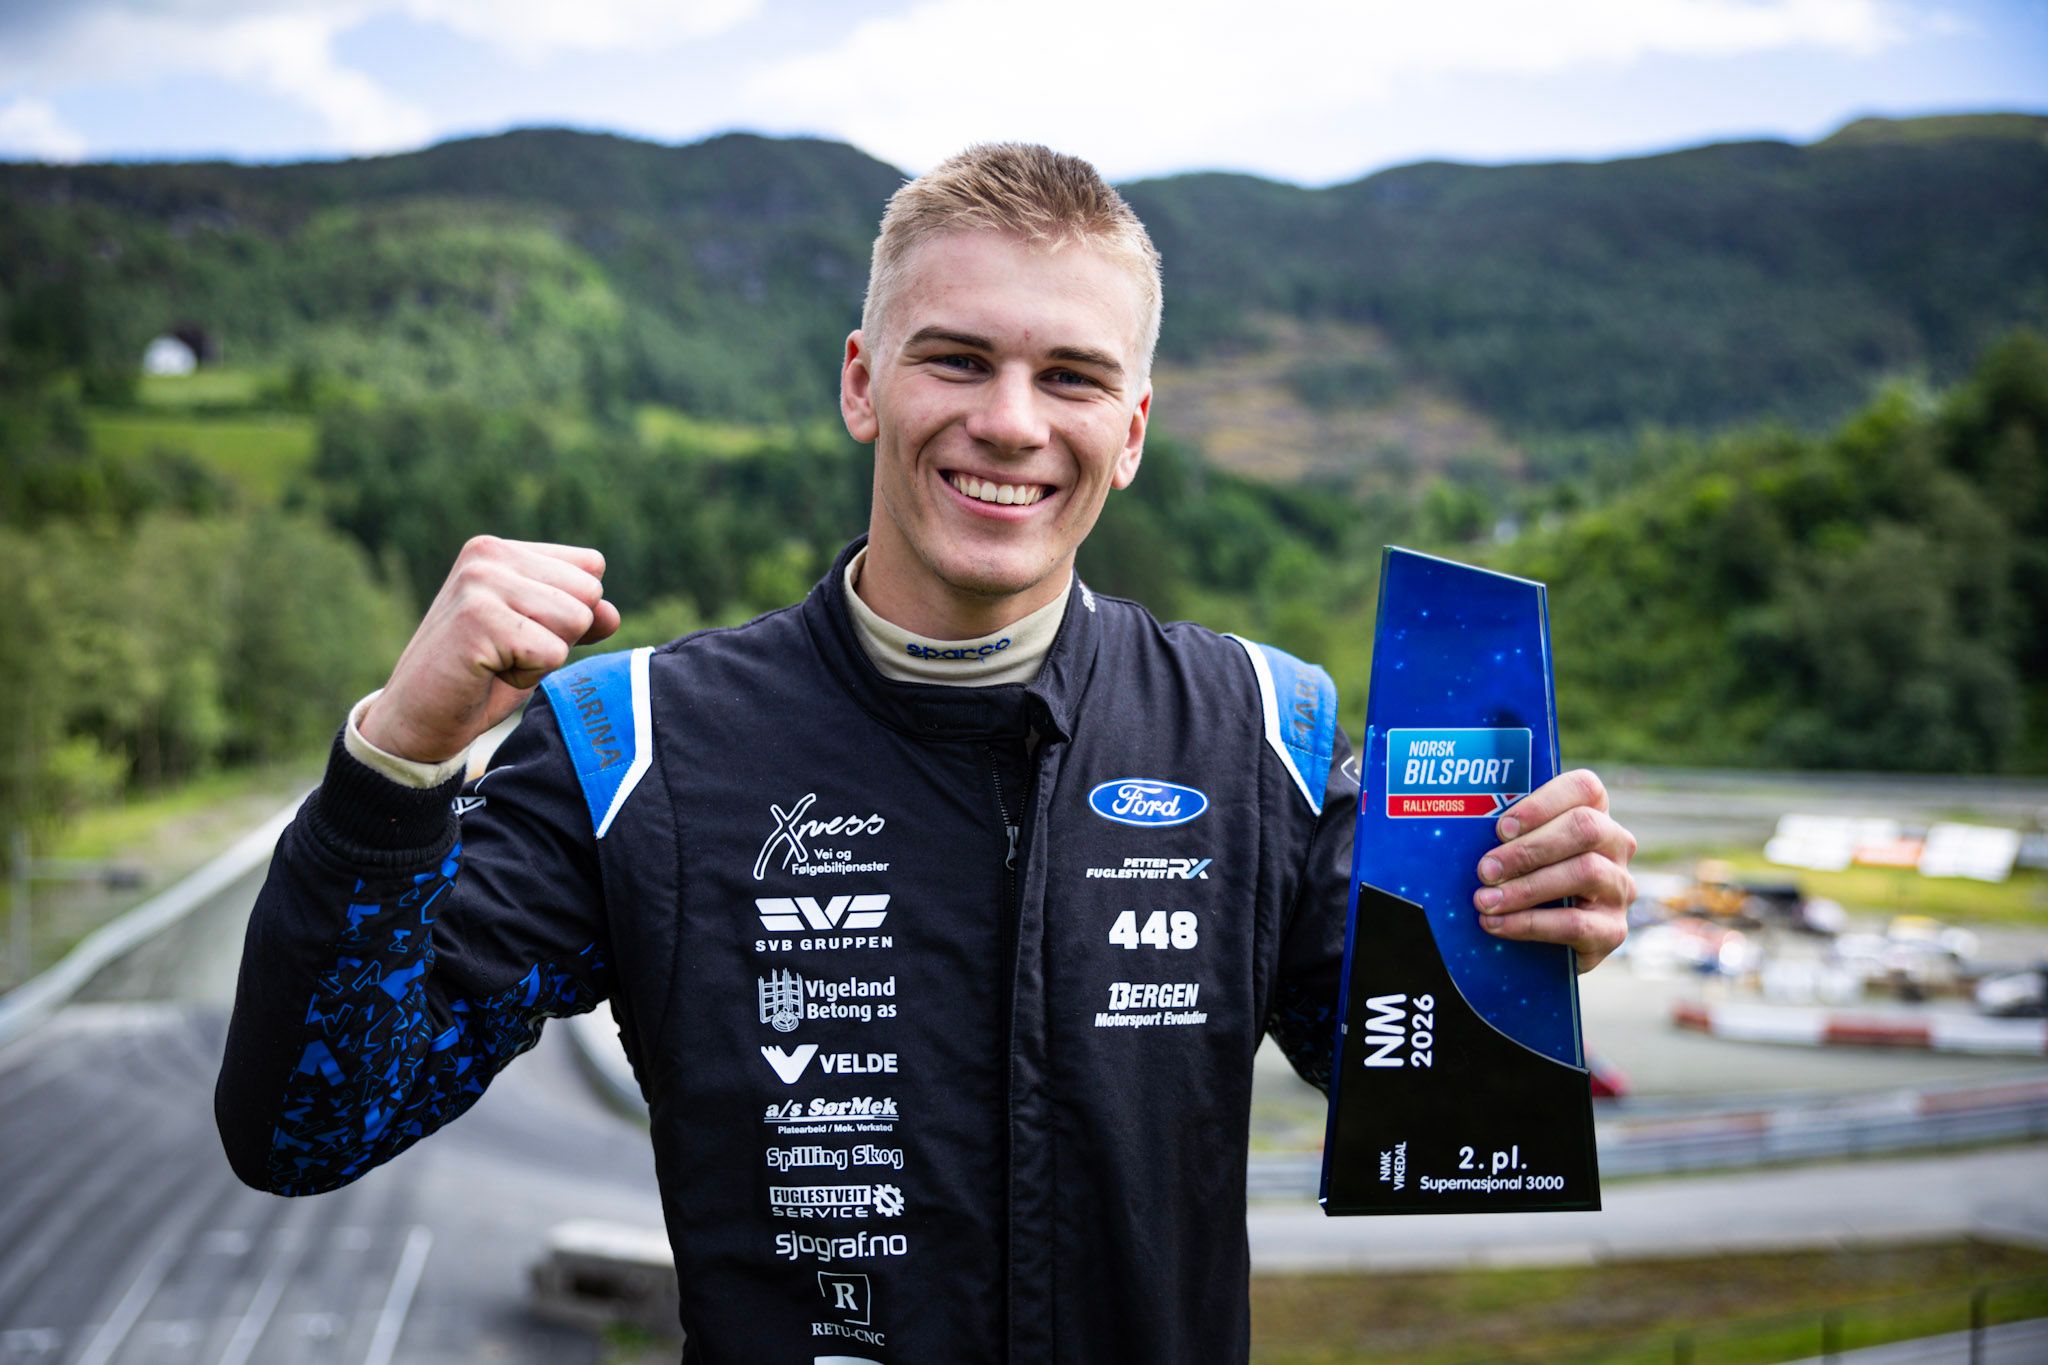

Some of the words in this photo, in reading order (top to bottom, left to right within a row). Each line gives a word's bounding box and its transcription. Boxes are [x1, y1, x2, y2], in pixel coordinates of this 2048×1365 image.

[906, 638, 1011, 660] sparco
[1409, 741, 1456, 757] NORSK
[1404, 758, 1514, 785] BILSPORT
[1112, 784, 1181, 817] Ford
[1403, 800, 1465, 813] RALLYCROSS
[814, 849, 833, 860] Vei
[836, 850, 852, 861] og
[1123, 858, 1168, 868] PETTER
[791, 861, 890, 876] Følgebiltjenester
[1086, 868, 1167, 879] FUGLESTVEIT
[1108, 910, 1199, 949] 448
[755, 939, 793, 951] SVB
[800, 936, 893, 951] GRUPPEN
[805, 976, 896, 1002] Vigeland
[807, 1002, 872, 1022] Betong
[877, 1004, 897, 1018] as
[1094, 1012, 1162, 1028] Motorsport
[1163, 1011, 1208, 1025] Evolution
[1364, 994, 1407, 1067] NM
[1411, 994, 1434, 1067] 2026
[819, 1053, 899, 1073] VELDE
[765, 1099, 803, 1117] a/s
[808, 1096, 898, 1116] SørMek
[778, 1124, 827, 1134] Platearbeid
[834, 1123, 855, 1133] Mek.
[857, 1123, 893, 1132] Verksted
[766, 1146, 848, 1172] Spilling
[852, 1144, 904, 1169] Skog
[1380, 1151, 1392, 1181] NMK
[1393, 1141, 1407, 1191] VIKEDAL
[1458, 1146, 1485, 1169] 2.
[1492, 1145, 1527, 1175] pl.
[1420, 1175, 1522, 1193] Supernasjonal
[1525, 1176, 1565, 1190] 3000
[773, 1188, 867, 1203] FUGLESTVEIT
[772, 1206, 869, 1218] SERVICE
[775, 1230, 908, 1262] sjograf.no
[832, 1282, 859, 1310] R
[811, 1322, 885, 1346] RETU-CNC
